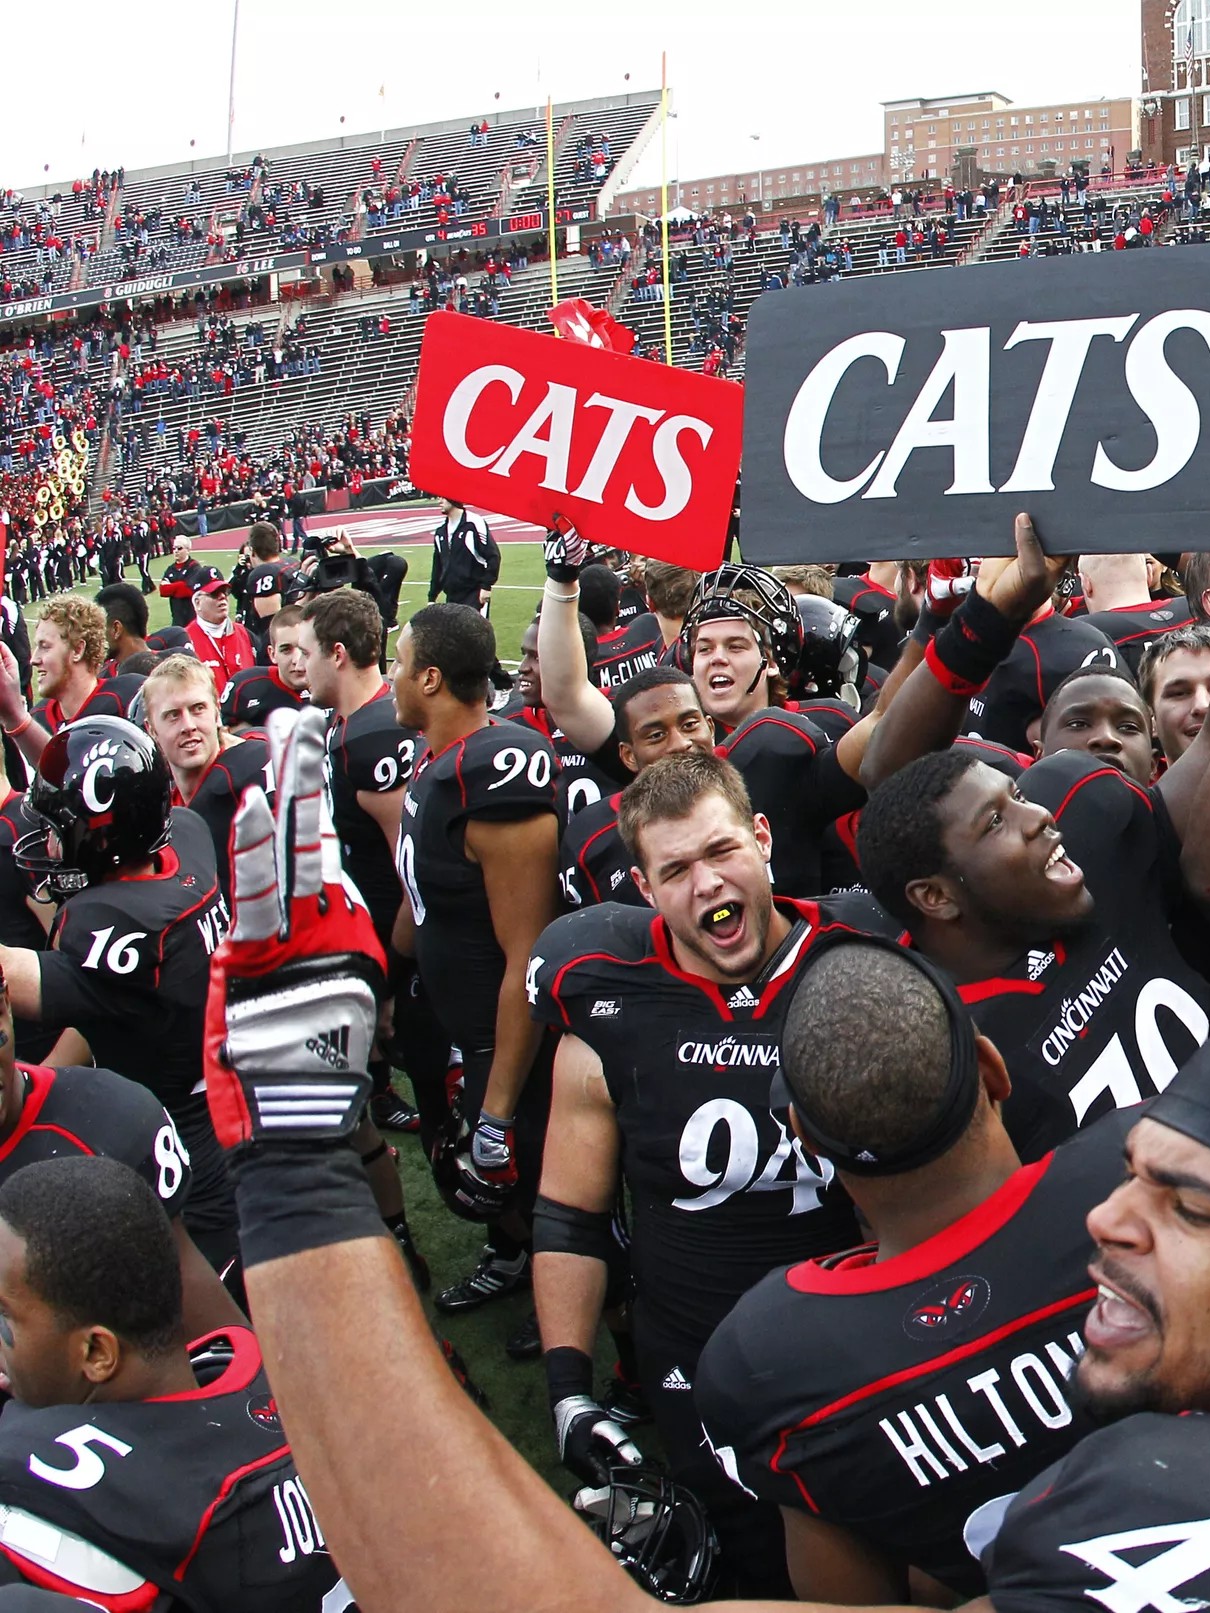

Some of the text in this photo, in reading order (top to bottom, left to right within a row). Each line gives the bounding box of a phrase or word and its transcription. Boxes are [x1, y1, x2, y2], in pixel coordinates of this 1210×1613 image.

[555, 209, 571, 223] 27
[437, 230, 446, 240] 4
[471, 222, 487, 236] 35
[253, 259, 275, 272] LEE
[103, 276, 174, 299] 8 GUIDUGLI
[4, 299, 53, 318] O'BRIEN
[441, 364, 714, 521] CATS
[256, 576, 273, 593] 18
[374, 739, 415, 792] 93
[487, 747, 550, 791] 90
[81, 925, 147, 974] 16
[1029, 951, 1055, 982] adidas
[591, 1007, 621, 1017] EAST
[595, 1000, 615, 1008] BIG
[727, 999, 760, 1008] adidas
[1041, 947, 1129, 1066] CINCINNATI
[677, 1036, 781, 1067] CINCINNA
[671, 1098, 835, 1216] 94
[663, 1380, 691, 1389] adidas
[879, 1332, 1084, 1486] HILTON
[29, 1424, 133, 1490] 5
